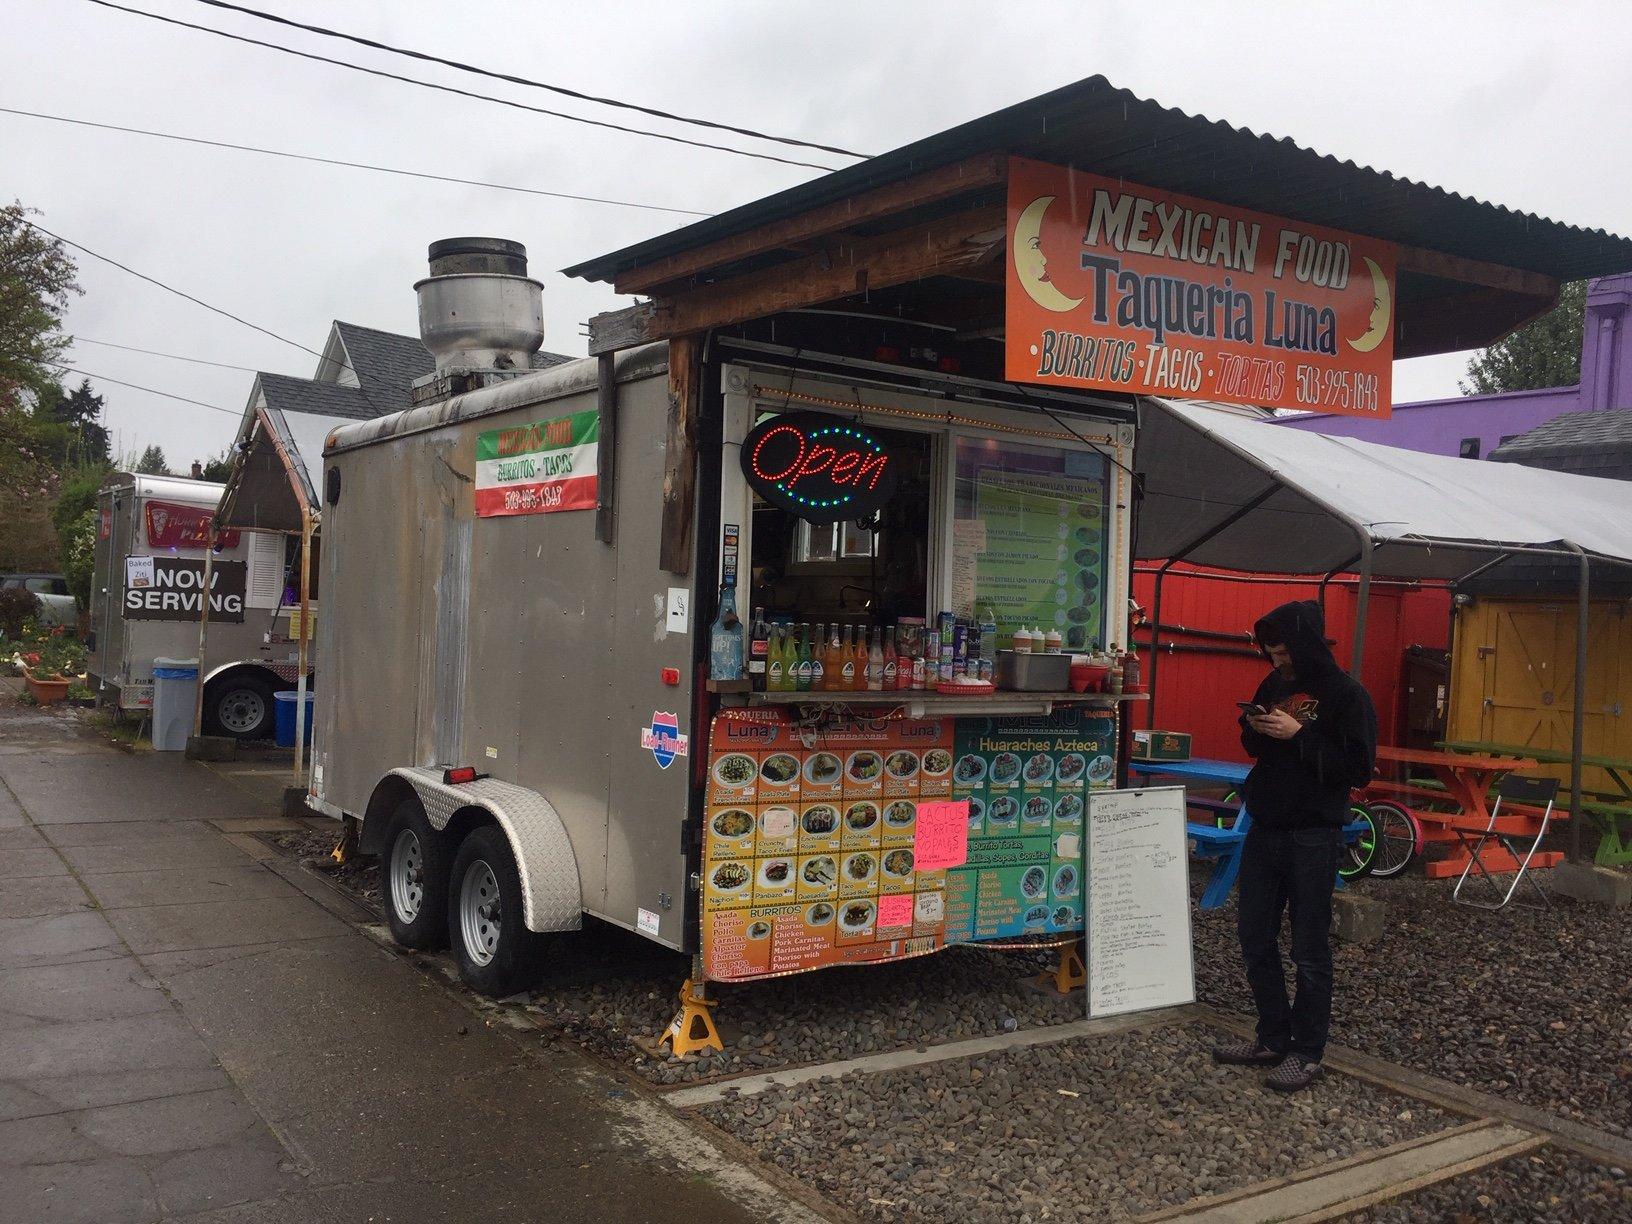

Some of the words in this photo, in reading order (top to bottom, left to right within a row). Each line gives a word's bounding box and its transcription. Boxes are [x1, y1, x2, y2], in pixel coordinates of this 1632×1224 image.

[1082, 189, 1260, 274] MEXICAN
[1273, 229, 1351, 291] FOOD
[1081, 253, 1255, 346] Taqueria
[1264, 290, 1339, 357] Luna
[1036, 330, 1135, 384] BURRITOS
[1141, 345, 1204, 393] TACOS
[1217, 352, 1286, 401] TORTAS
[752, 423, 888, 492] Open
[497, 459, 536, 482] BURRITOS
[543, 452, 573, 477] TACOS
[156, 568, 219, 590] NOW
[126, 590, 242, 613] SERVING
[726, 710, 780, 720] TAQUERIA
[727, 722, 768, 738] Luna
[900, 721, 934, 737] Luna
[642, 731, 688, 755] Load-Runner
[979, 737, 1050, 752] Huaraches
[1054, 738, 1098, 752] Azteca
[918, 805, 965, 824] CACTUS
[709, 897, 734, 905] Nachos
[750, 905, 802, 918] BURRITOS
[713, 919, 744, 928] Choriso
[775, 923, 804, 931] Choriso
[713, 928, 734, 936] Pollo
[774, 930, 804, 939] Chicken
[773, 945, 811, 955] Marinated
[813, 942, 830, 950] Meat
[774, 938, 792, 947] Pork
[794, 936, 825, 944] Carnitas
[773, 954, 802, 963] Choriso
[804, 951, 820, 959] with
[772, 962, 800, 971] Potatos
